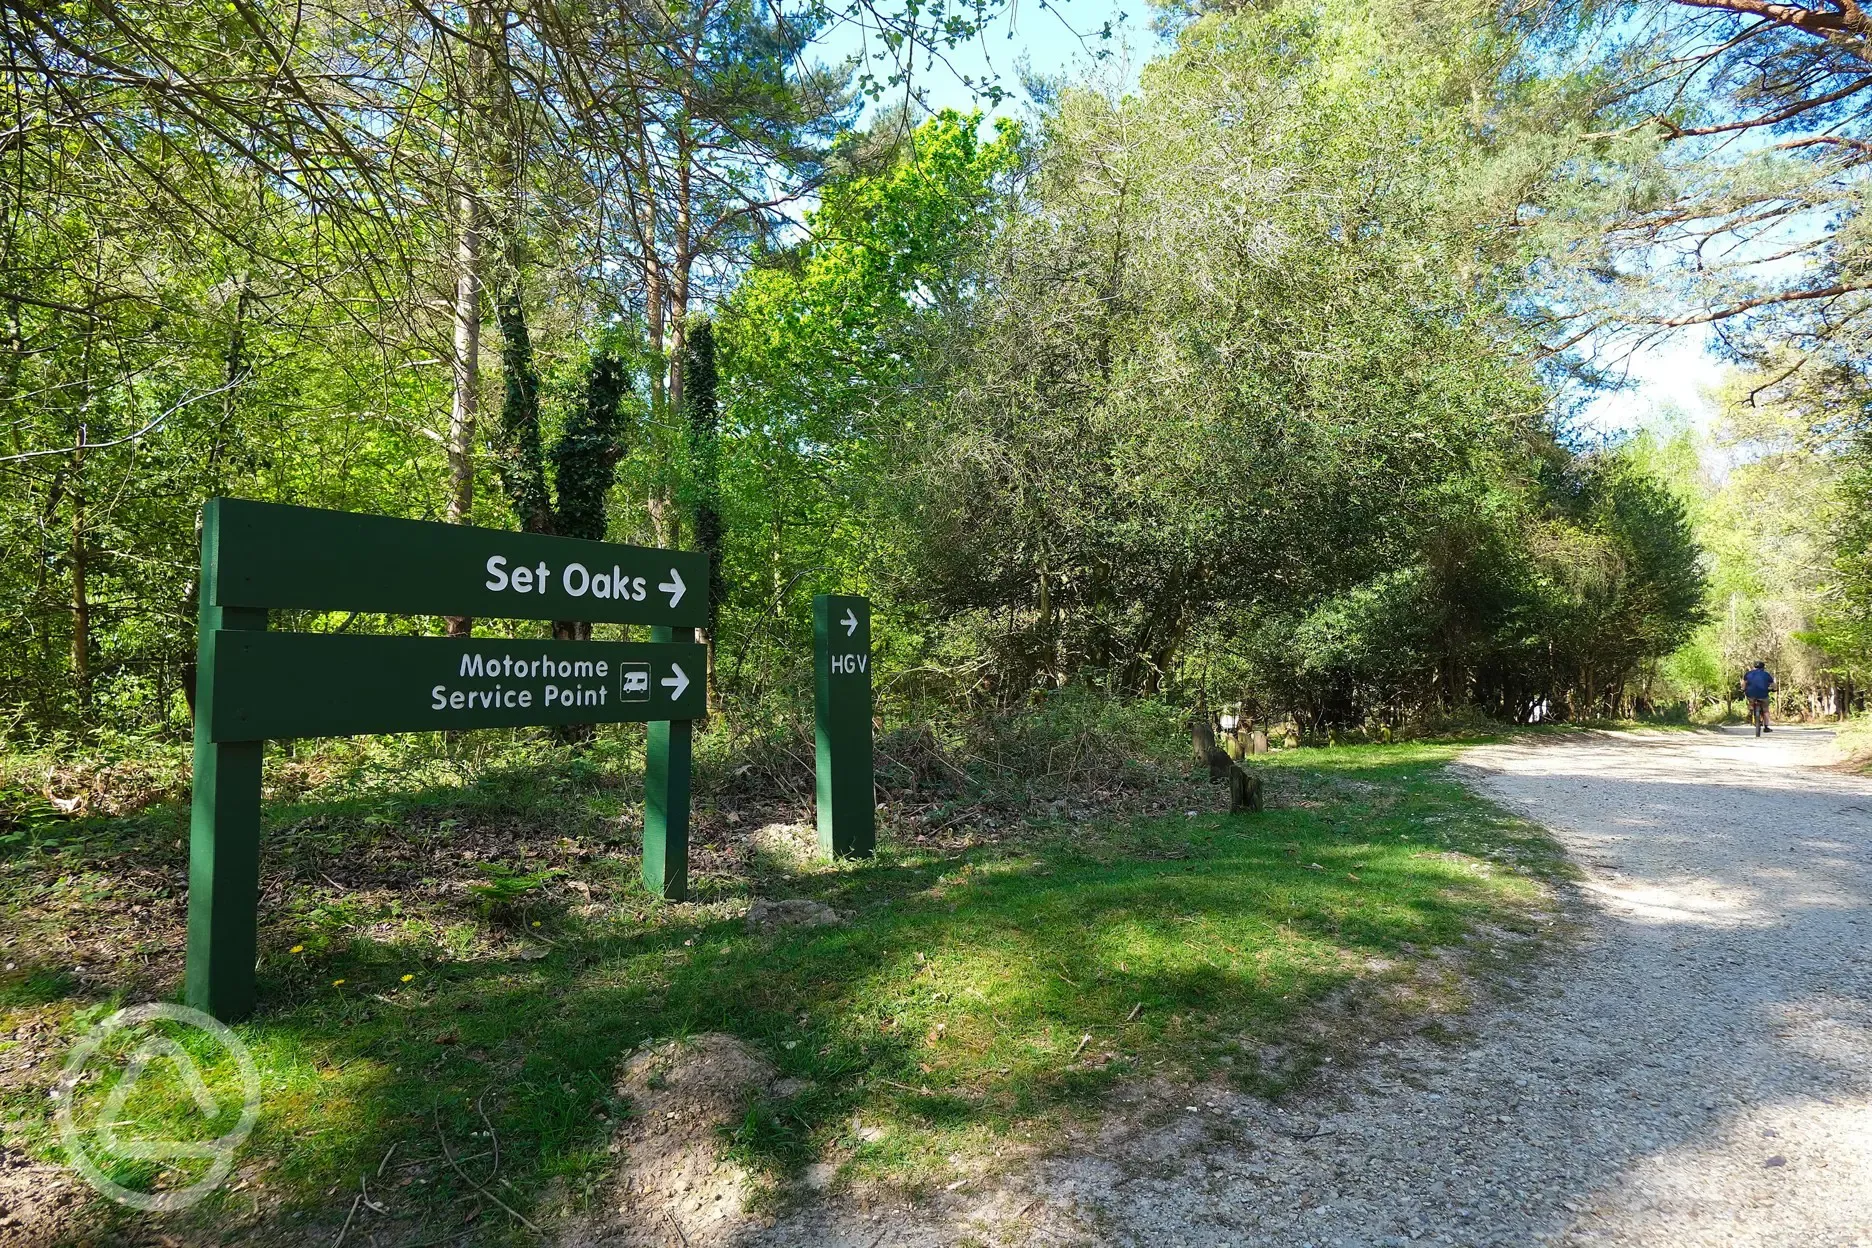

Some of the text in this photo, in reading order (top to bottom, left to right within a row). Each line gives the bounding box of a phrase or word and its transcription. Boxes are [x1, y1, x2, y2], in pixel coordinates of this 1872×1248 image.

[484, 555, 648, 603] Set Oaks
[459, 652, 609, 679] Motorhome
[831, 653, 868, 674] HGV
[431, 684, 609, 710] Service Point
